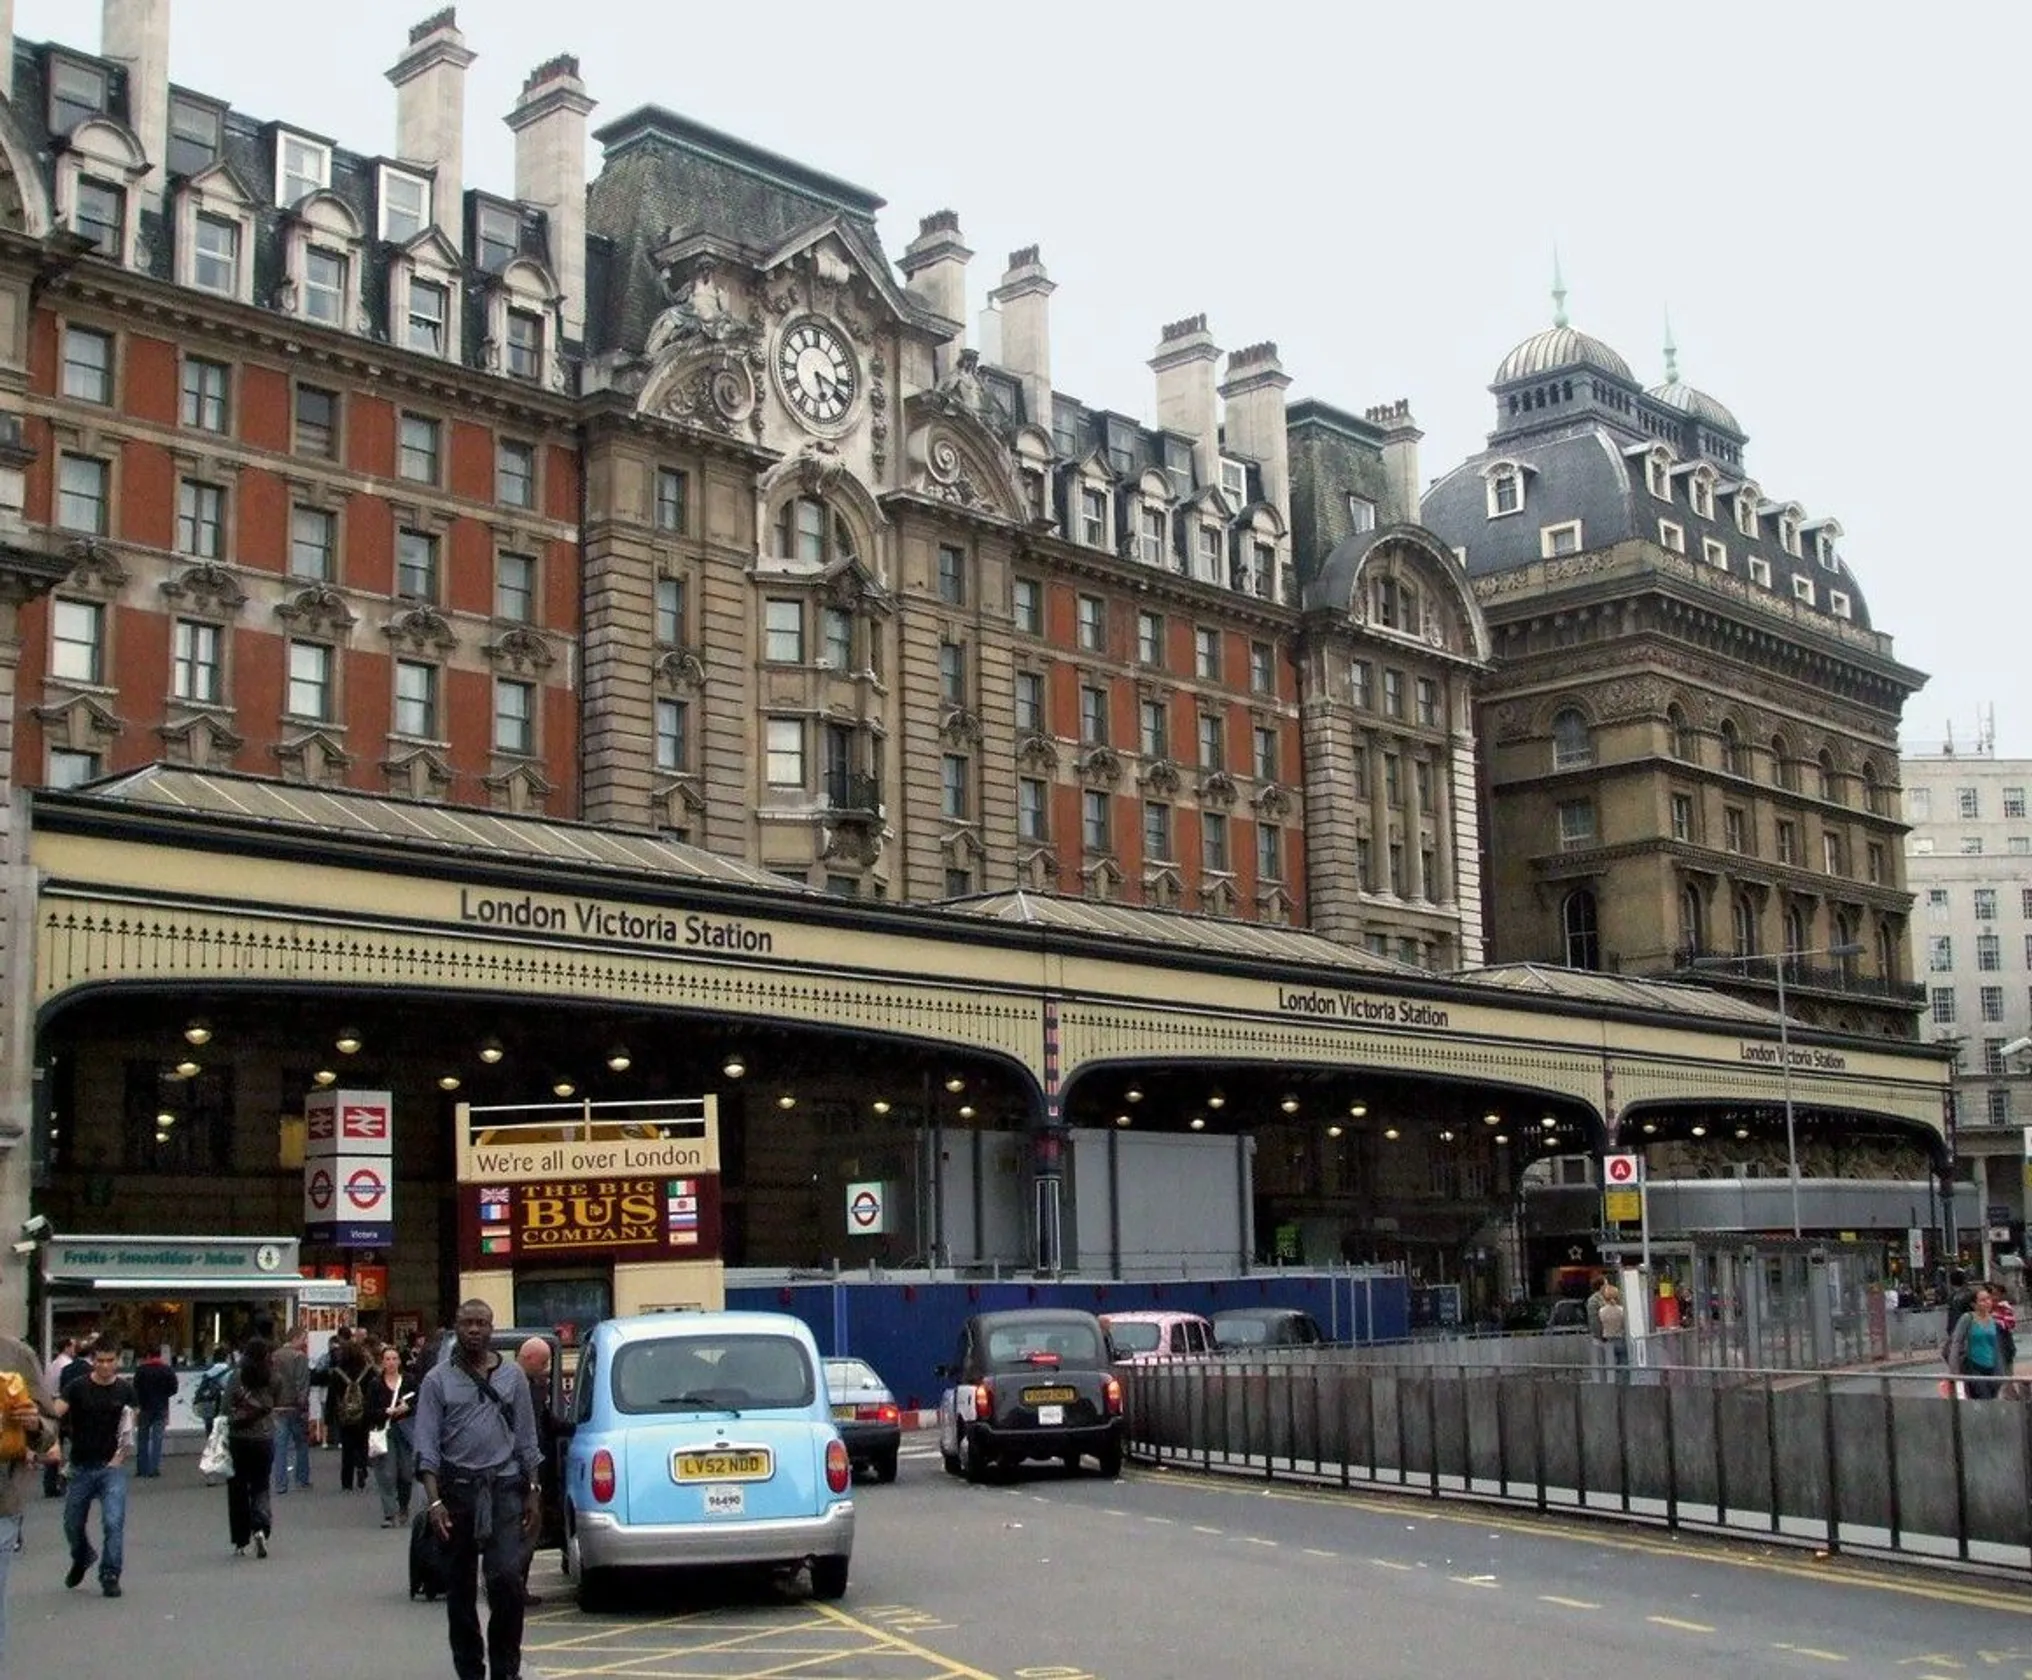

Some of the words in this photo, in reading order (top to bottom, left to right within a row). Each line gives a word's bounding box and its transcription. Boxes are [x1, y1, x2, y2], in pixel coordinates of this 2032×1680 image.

[460, 888, 567, 930] London
[574, 901, 677, 942] Victoria
[684, 914, 773, 953] Station
[1278, 987, 1336, 1015] London
[1338, 993, 1396, 1021] Victoria
[1399, 1000, 1449, 1027] Station
[476, 1152, 534, 1173] We're
[541, 1149, 564, 1171] all
[571, 1153, 617, 1170] over
[624, 1145, 701, 1168] London
[1614, 1162, 1627, 1177] A
[521, 1183, 588, 1198] THE
[599, 1180, 655, 1195] BIG
[521, 1194, 658, 1229] BUS
[522, 1225, 658, 1244] COMPANY
[684, 1458, 726, 1474] LV52
